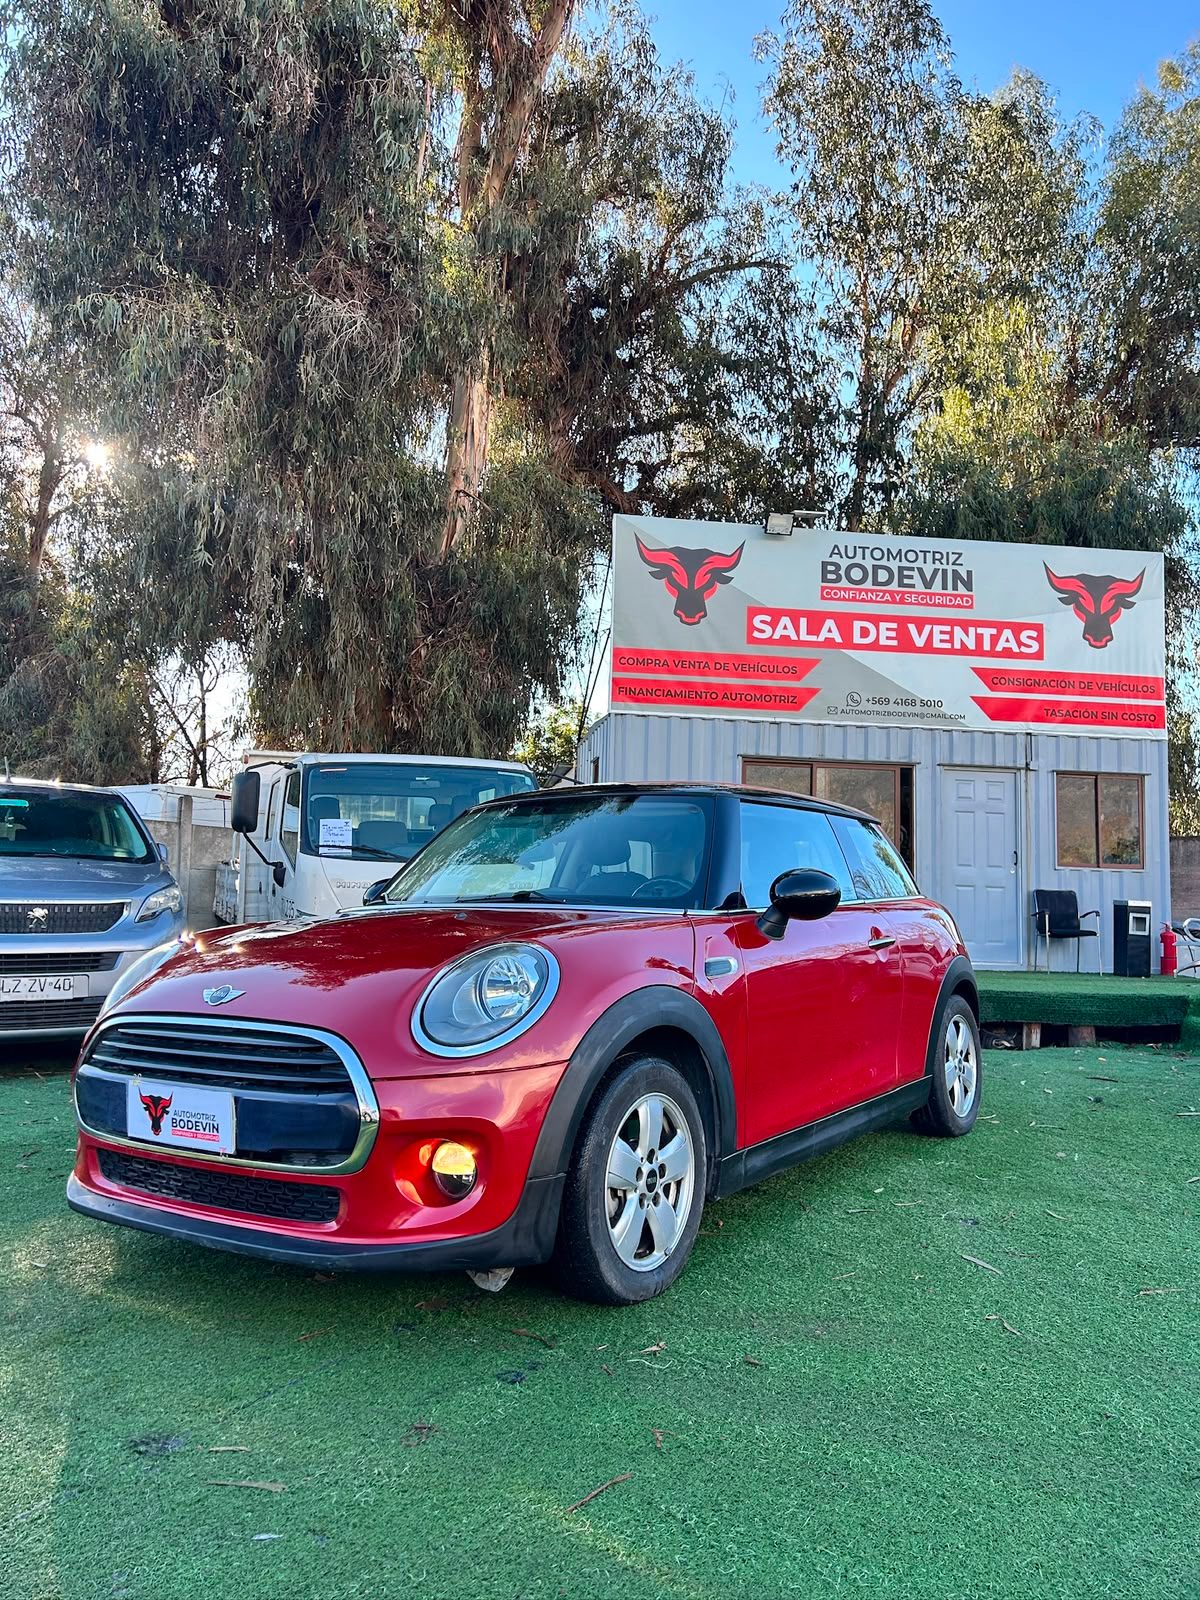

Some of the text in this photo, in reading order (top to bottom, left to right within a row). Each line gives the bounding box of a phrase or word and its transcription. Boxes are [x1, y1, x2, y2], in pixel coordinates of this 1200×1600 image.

[829, 544, 964, 566] AUTOMOTRIZ
[821, 561, 974, 592] BODEVIN
[823, 589, 972, 607] CONFIANZA Y SEGURIDAD
[752, 614, 1040, 654] SALA DE VENTAS
[618, 656, 798, 675] COMPRA VENTA DE VEHÍCULOS
[991, 676, 1156, 694] CONSIGNACIÓN DE VEHÍCULOS
[617, 686, 798, 705] FINANCIAMIENTO AUTOMOTRIZ
[865, 696, 944, 709] +569 4168 5010
[840, 708, 966, 720] AUTOMOTRIZBODEVIN@GMAIL.COM
[1044, 707, 1157, 723] TASACIÓN SIN COSTO
[173, 1109, 216, 1121] AUTOMOTRIZ
[171, 1118, 220, 1133] BODEVIN
